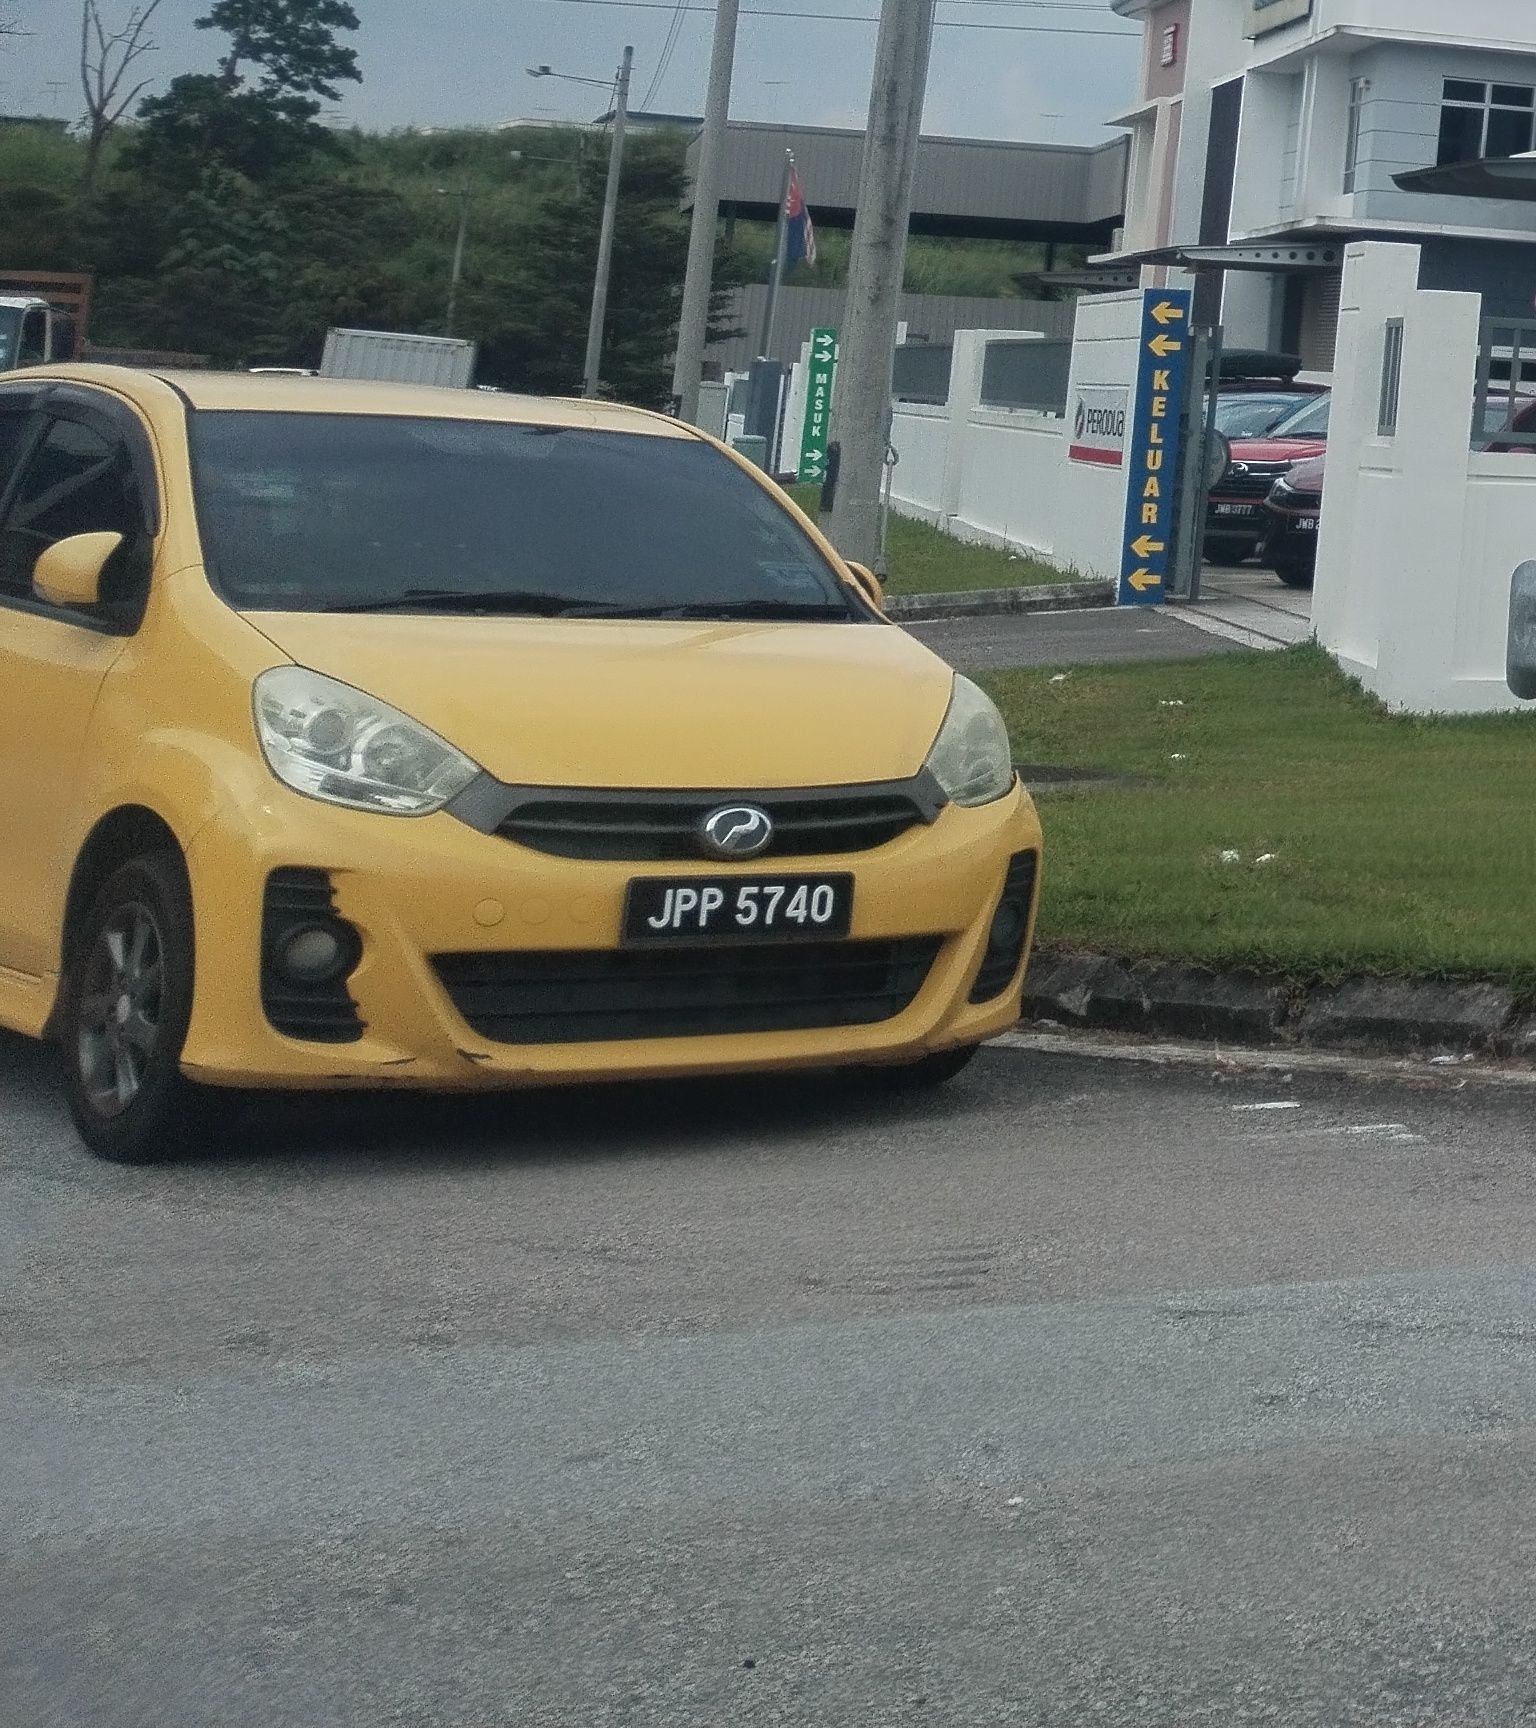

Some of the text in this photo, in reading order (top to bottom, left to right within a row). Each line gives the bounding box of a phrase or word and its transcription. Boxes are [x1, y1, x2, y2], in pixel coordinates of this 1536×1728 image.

[811, 373, 828, 437] MASUK
[1141, 369, 1170, 524] KELUAR
[648, 884, 835, 929] JPP 5740
